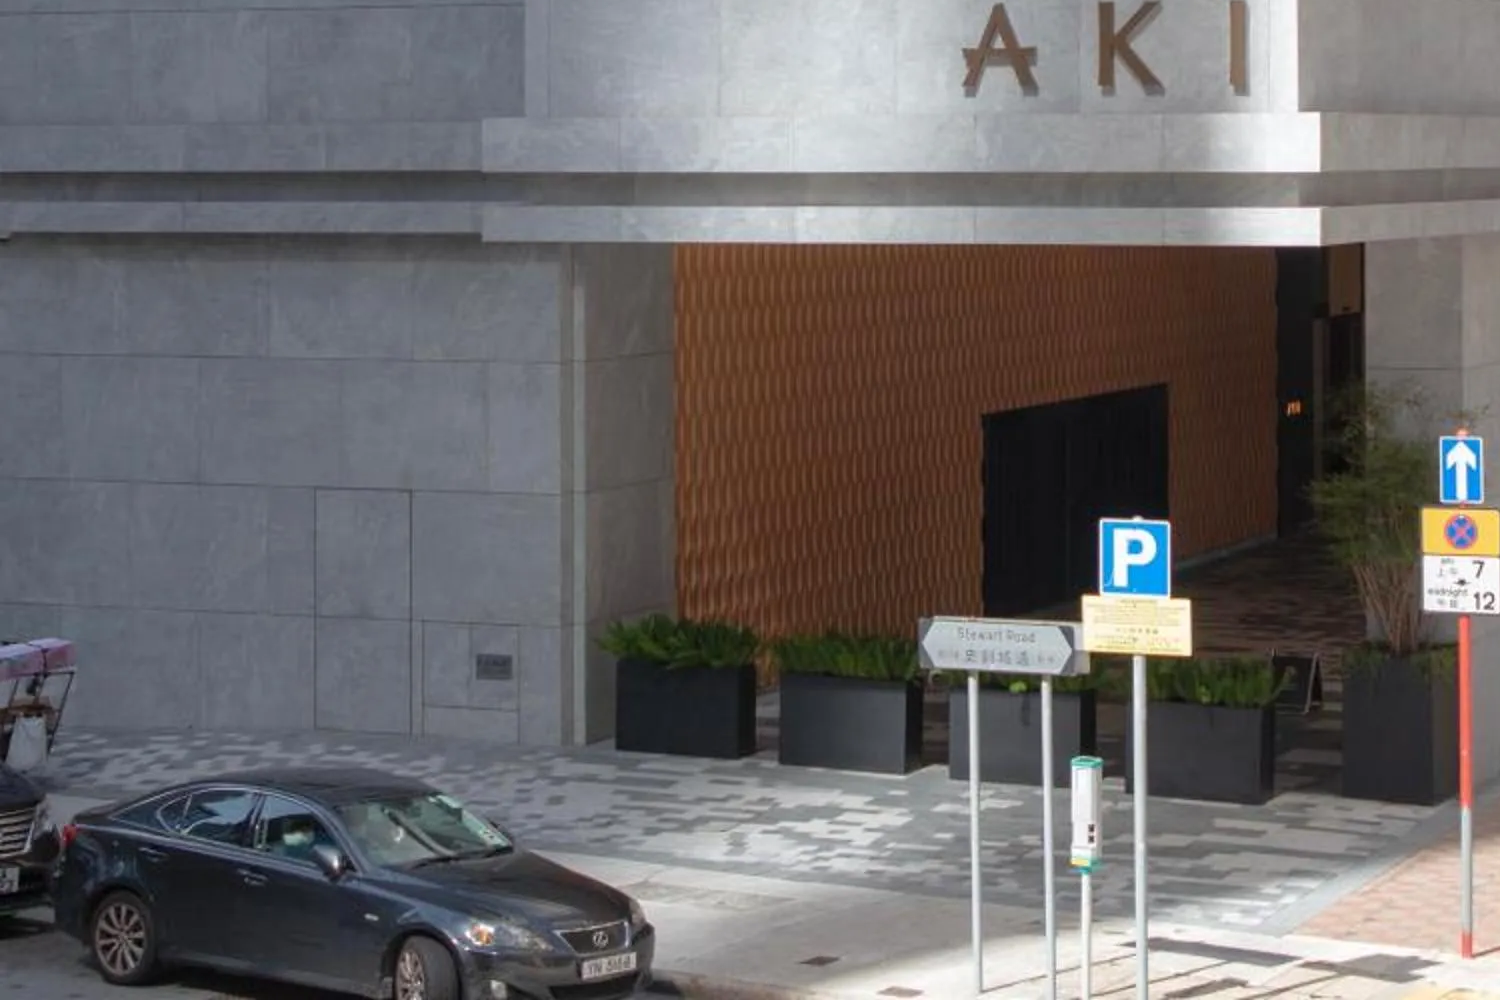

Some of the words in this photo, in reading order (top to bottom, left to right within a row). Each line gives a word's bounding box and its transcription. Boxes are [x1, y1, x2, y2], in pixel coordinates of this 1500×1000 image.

[961, 0, 1248, 98] AKI
[1112, 527, 1158, 588] P
[1471, 559, 1486, 579] 7
[1473, 591, 1496, 611] 12
[957, 626, 1003, 642] Stewart
[1006, 628, 1037, 643] Road
